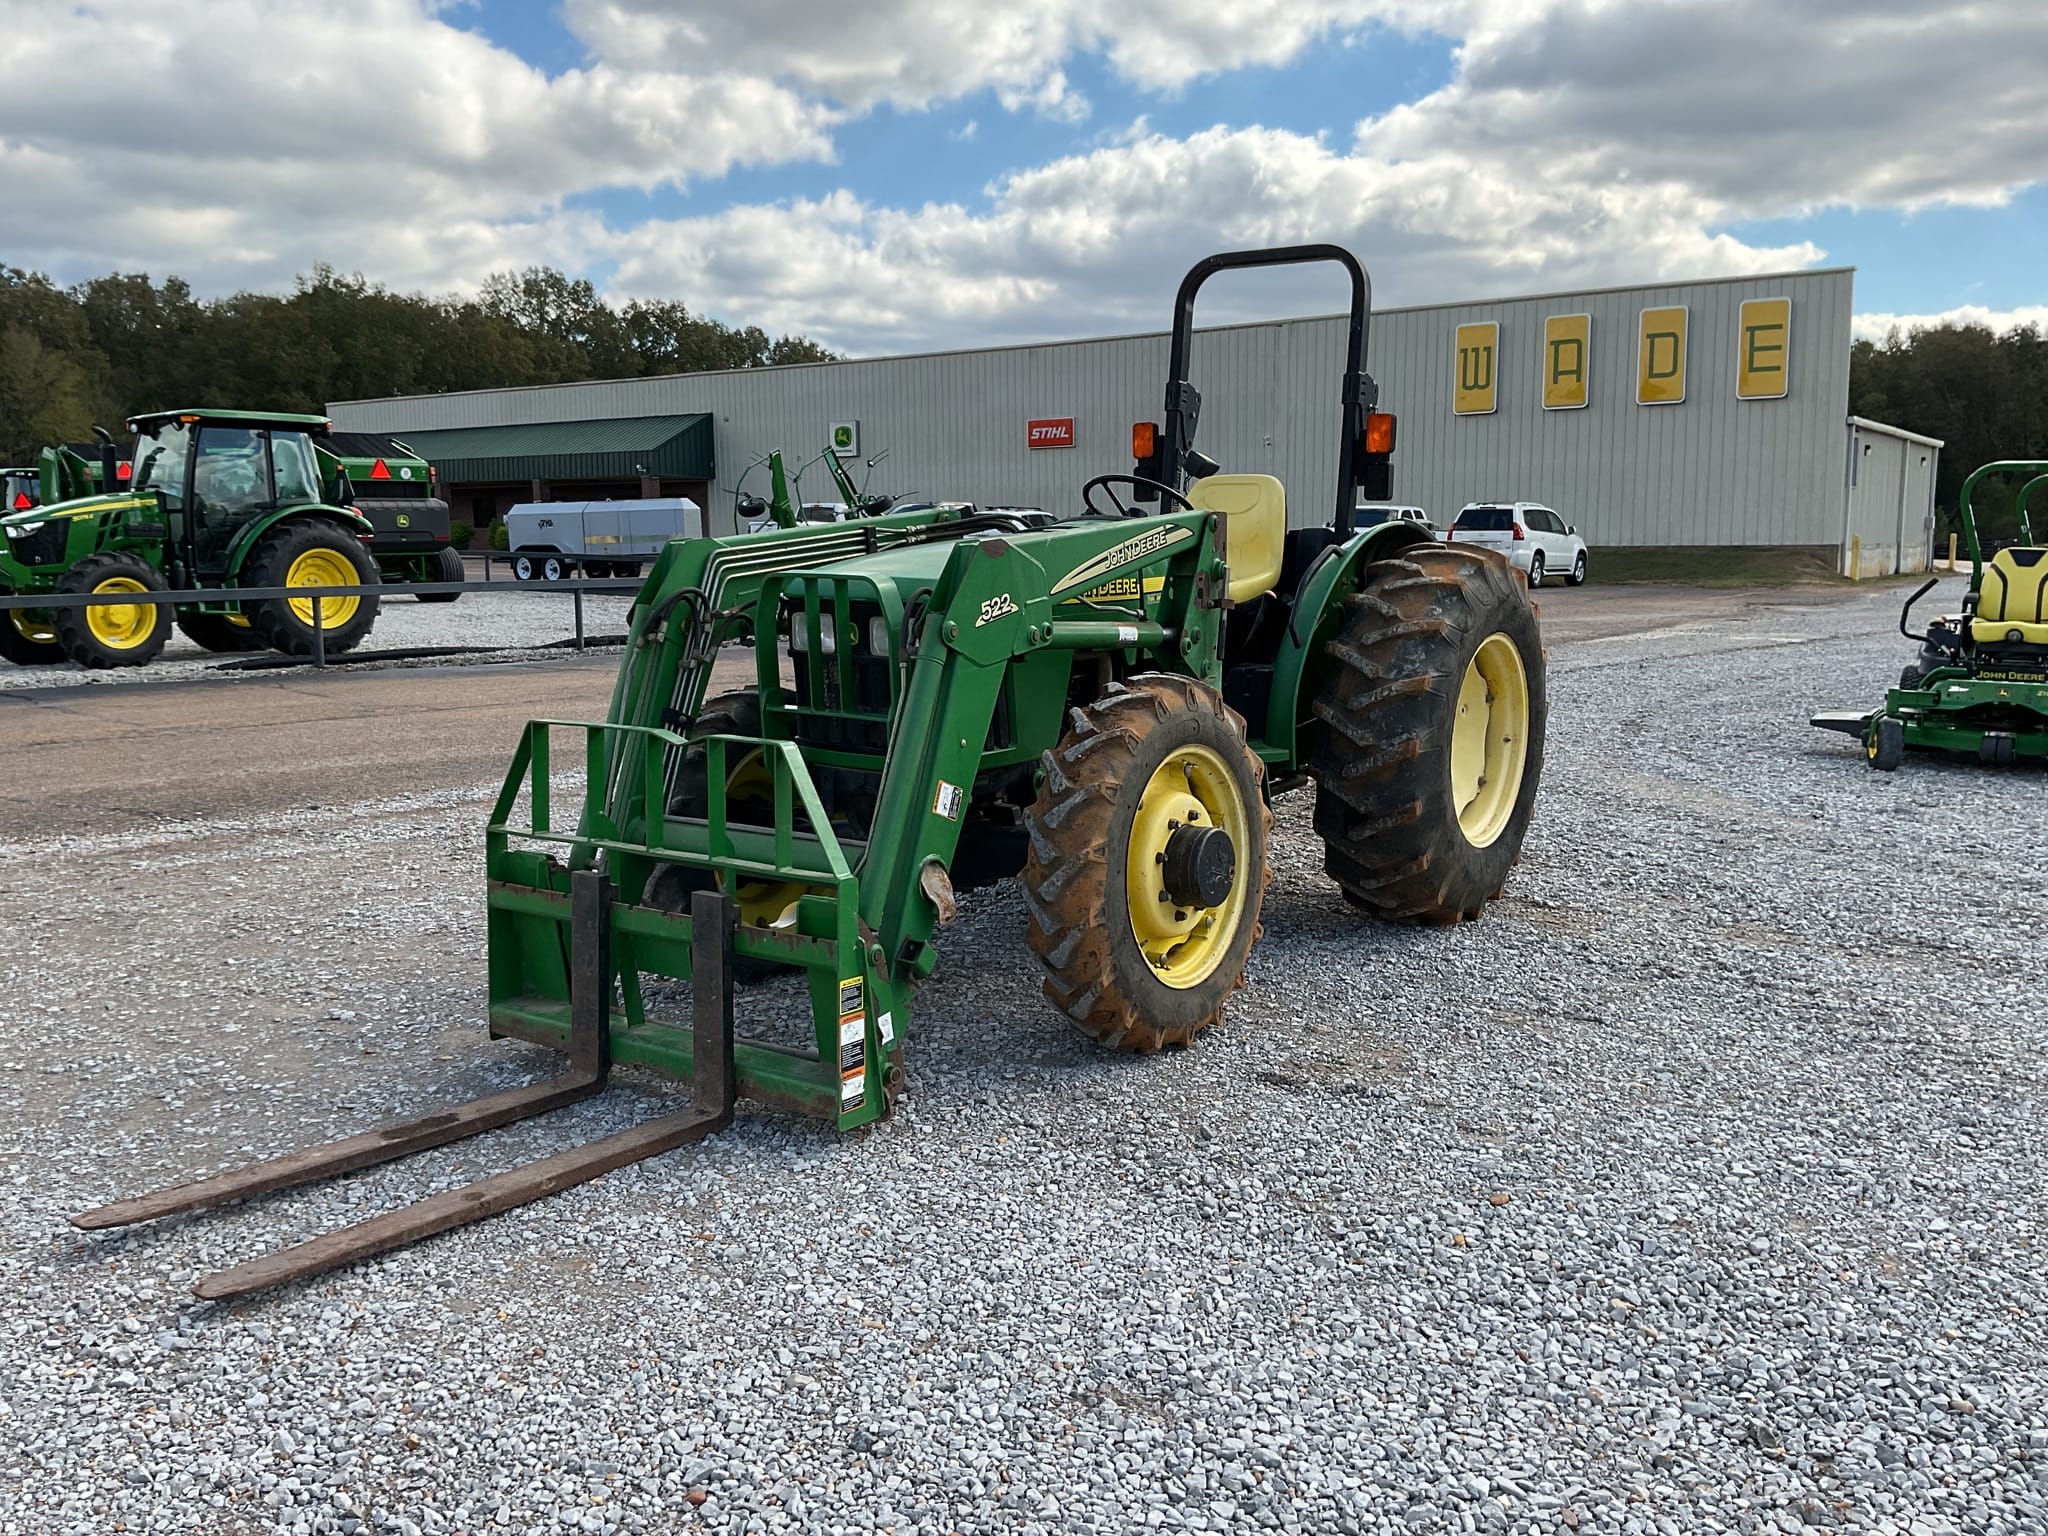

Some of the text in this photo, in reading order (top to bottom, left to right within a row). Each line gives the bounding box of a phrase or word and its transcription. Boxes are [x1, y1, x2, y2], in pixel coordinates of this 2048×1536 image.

[1460, 324, 1783, 391] WADE
[1030, 426, 1069, 440] STIHL
[1105, 530, 1167, 569] JOHN DEERE
[1099, 578, 1137, 596] DEERE
[981, 593, 1011, 621] 522
[1976, 670, 2046, 681] JOHN DEERE
